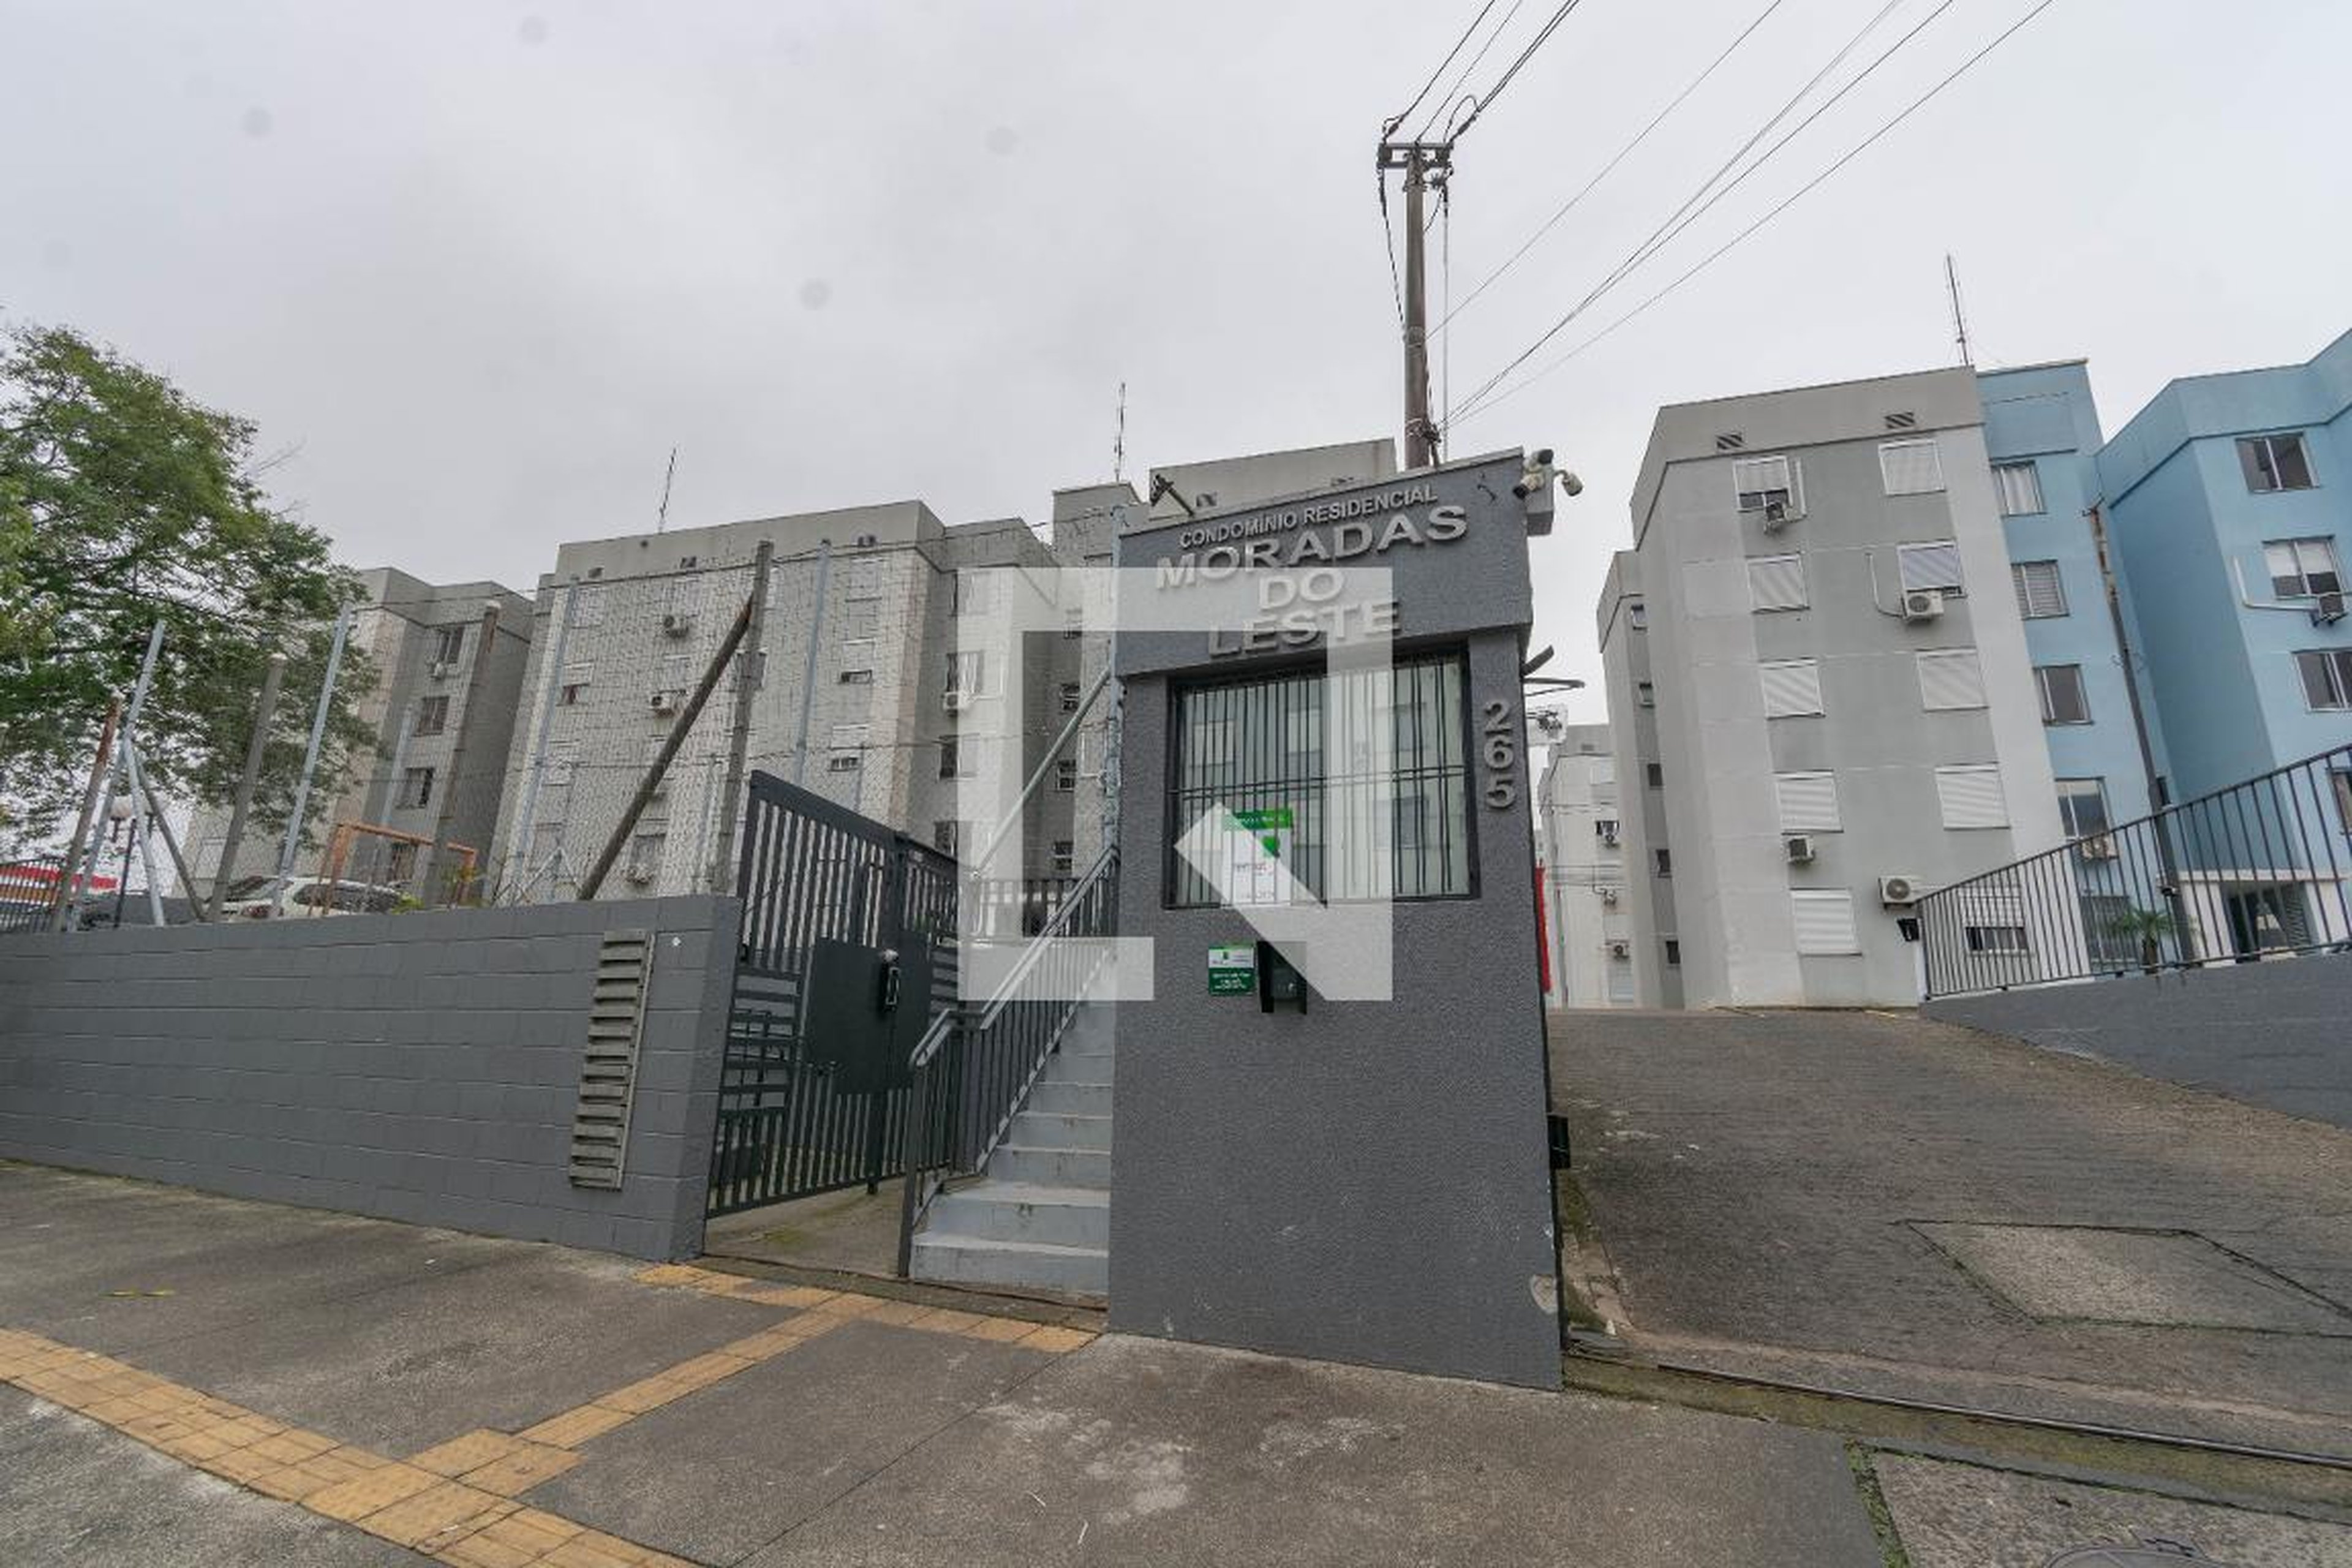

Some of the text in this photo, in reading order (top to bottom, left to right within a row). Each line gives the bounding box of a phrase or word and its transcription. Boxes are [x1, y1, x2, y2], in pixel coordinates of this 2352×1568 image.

[1303, 486, 1438, 524] RESIDENCIAL
[1158, 506, 1467, 588] MORADAS
[1260, 568, 1344, 609] DO
[1208, 603, 1399, 657] LESTE
[1485, 701, 1515, 809] 265
